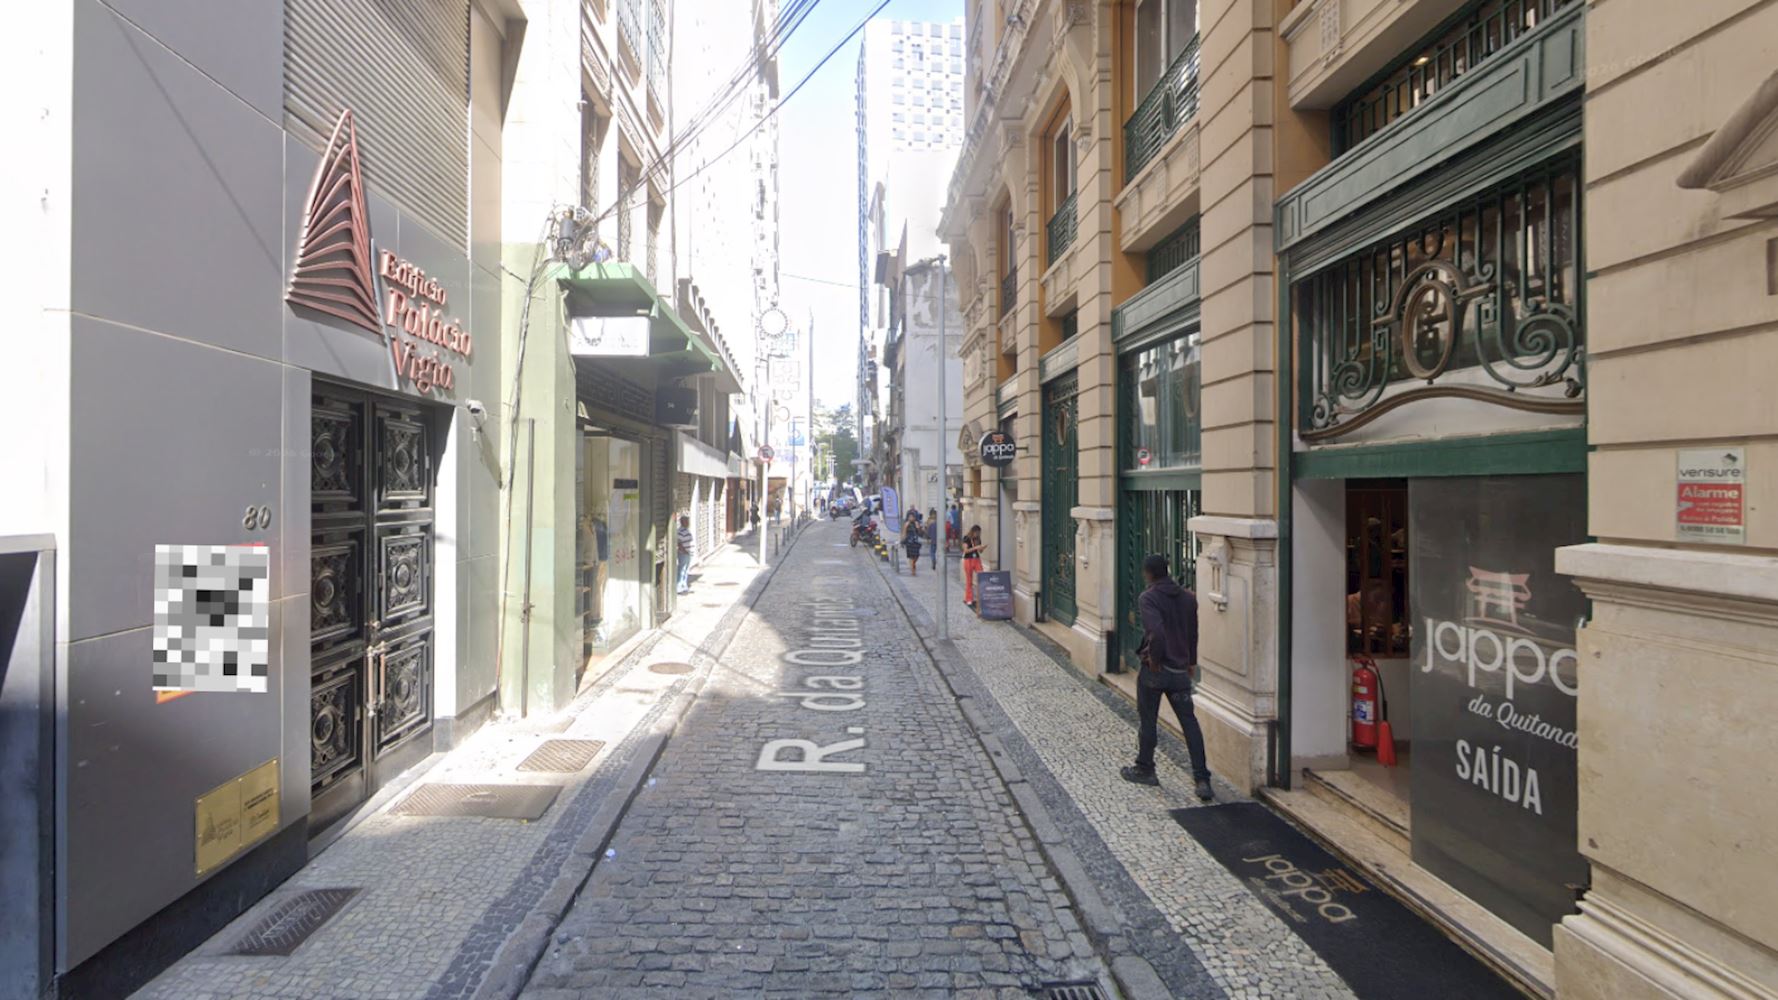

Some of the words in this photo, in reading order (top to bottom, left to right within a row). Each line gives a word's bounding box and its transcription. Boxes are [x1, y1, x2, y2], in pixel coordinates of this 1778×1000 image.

[386, 287, 471, 355] Palácio
[390, 335, 454, 395] Vigia
[1679, 467, 1742, 478] verisure
[1682, 486, 1740, 499] Alarme
[242, 505, 272, 530] 80
[1468, 694, 1493, 718] da
[1456, 739, 1543, 816] SAÍDA
